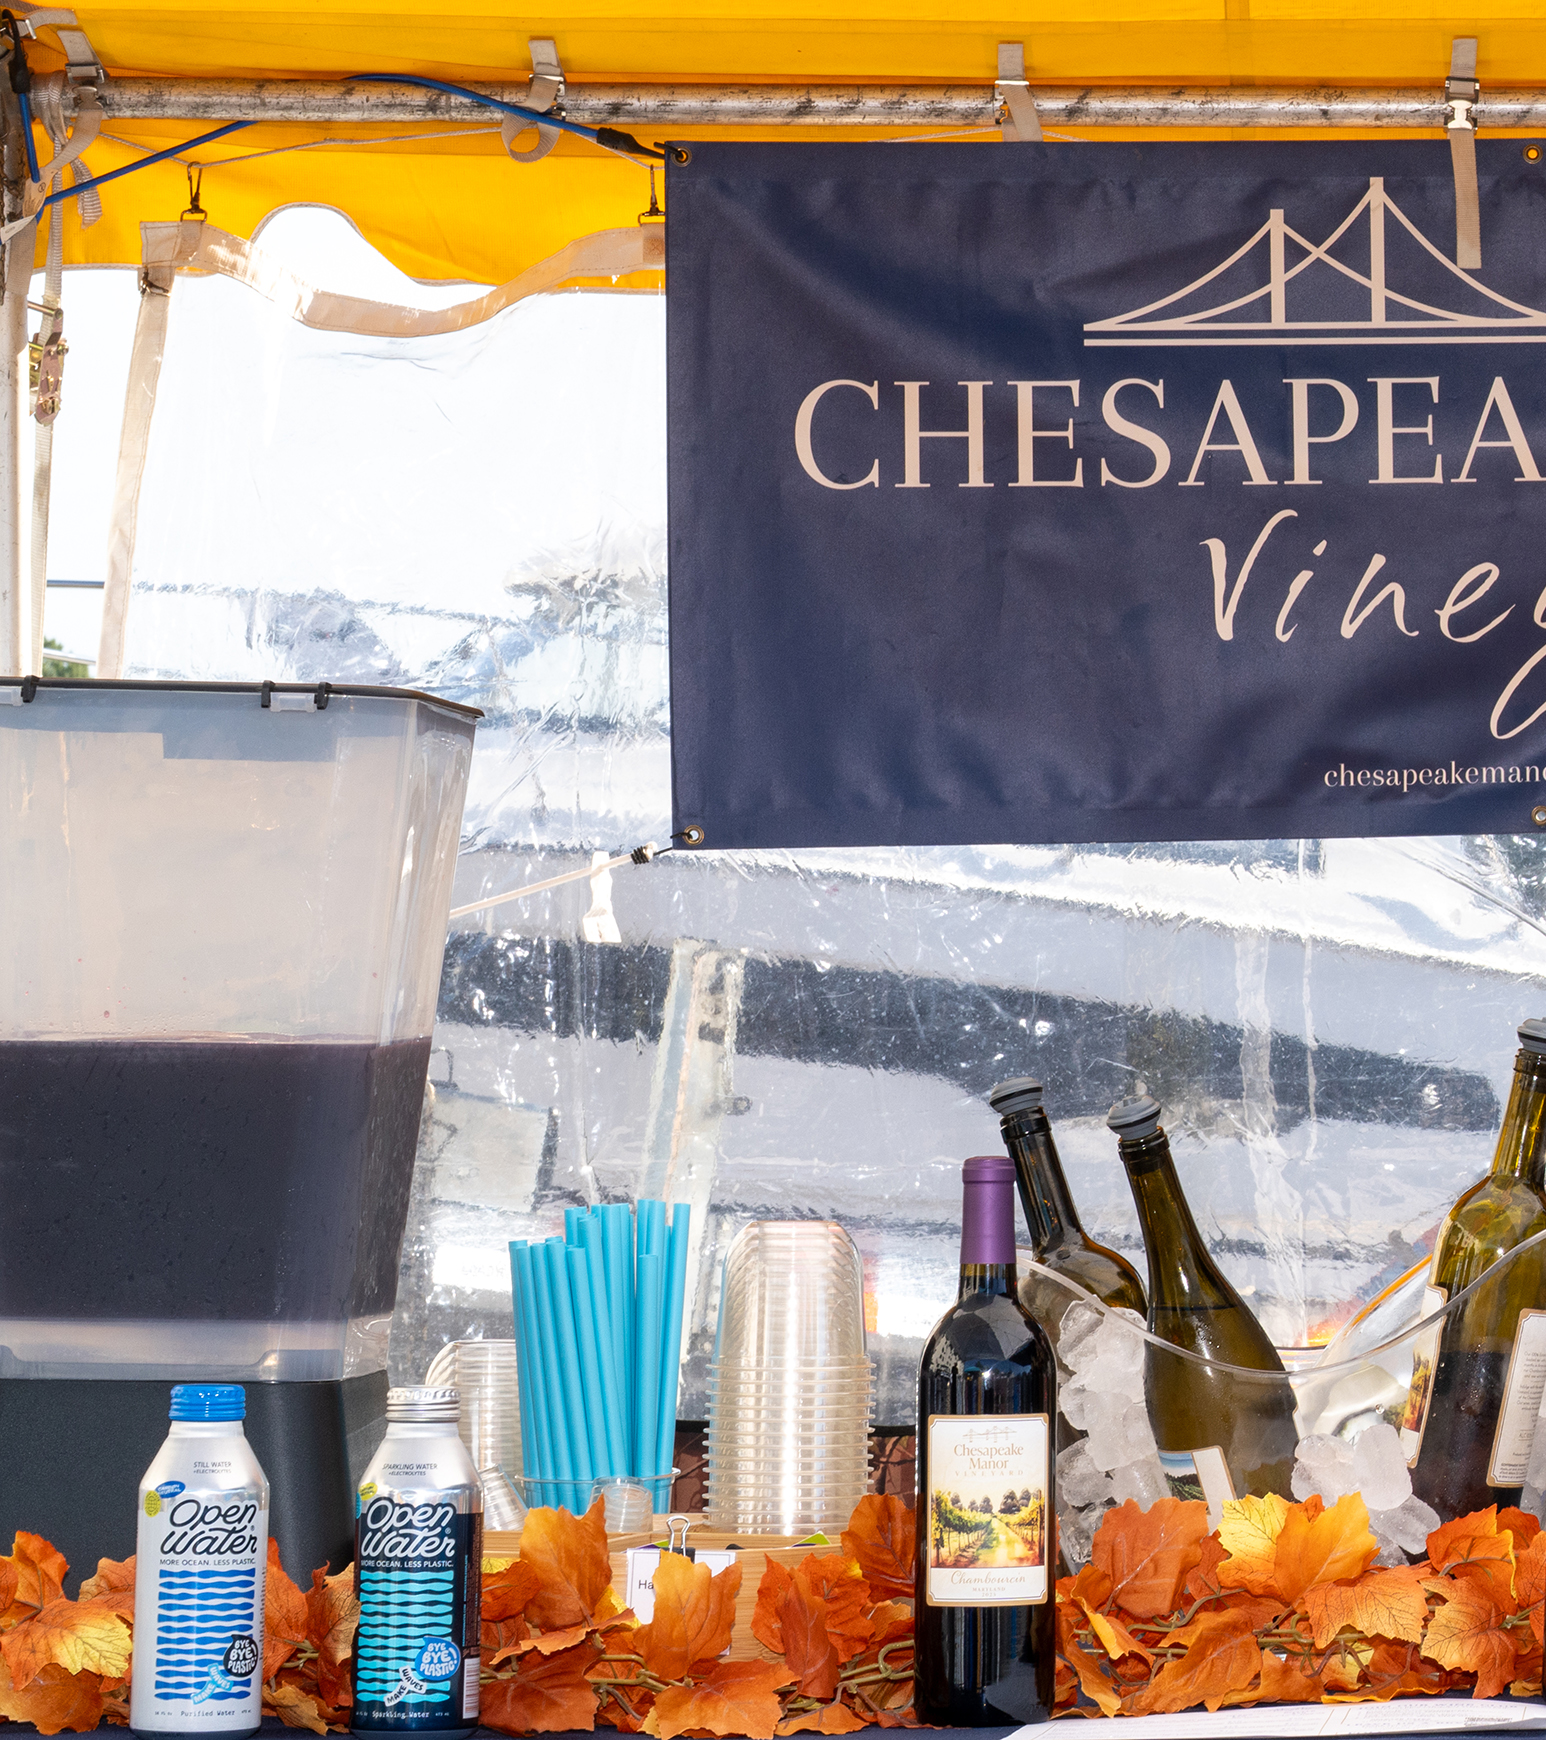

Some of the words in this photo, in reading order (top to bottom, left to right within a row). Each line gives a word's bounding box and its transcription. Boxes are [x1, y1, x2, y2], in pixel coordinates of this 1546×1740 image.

[953, 1443, 1024, 1459] Chesapeake
[382, 1463, 414, 1471] SPARKLING
[969, 1457, 1010, 1470] Manor
[169, 1499, 257, 1531] Open
[367, 1499, 454, 1533] Open
[160, 1525, 257, 1555] Water
[361, 1527, 456, 1558] Water
[404, 1560, 422, 1568] LESS
[950, 1569, 1026, 1586] Chambourcin
[234, 1639, 250, 1649] BYE
[427, 1643, 446, 1652] BYE
[230, 1648, 253, 1661] BYE
[422, 1650, 451, 1663] BYE
[402, 1668, 424, 1691] WAVES
[386, 1684, 407, 1704] MAKE
[372, 1710, 407, 1719] Sparkling
